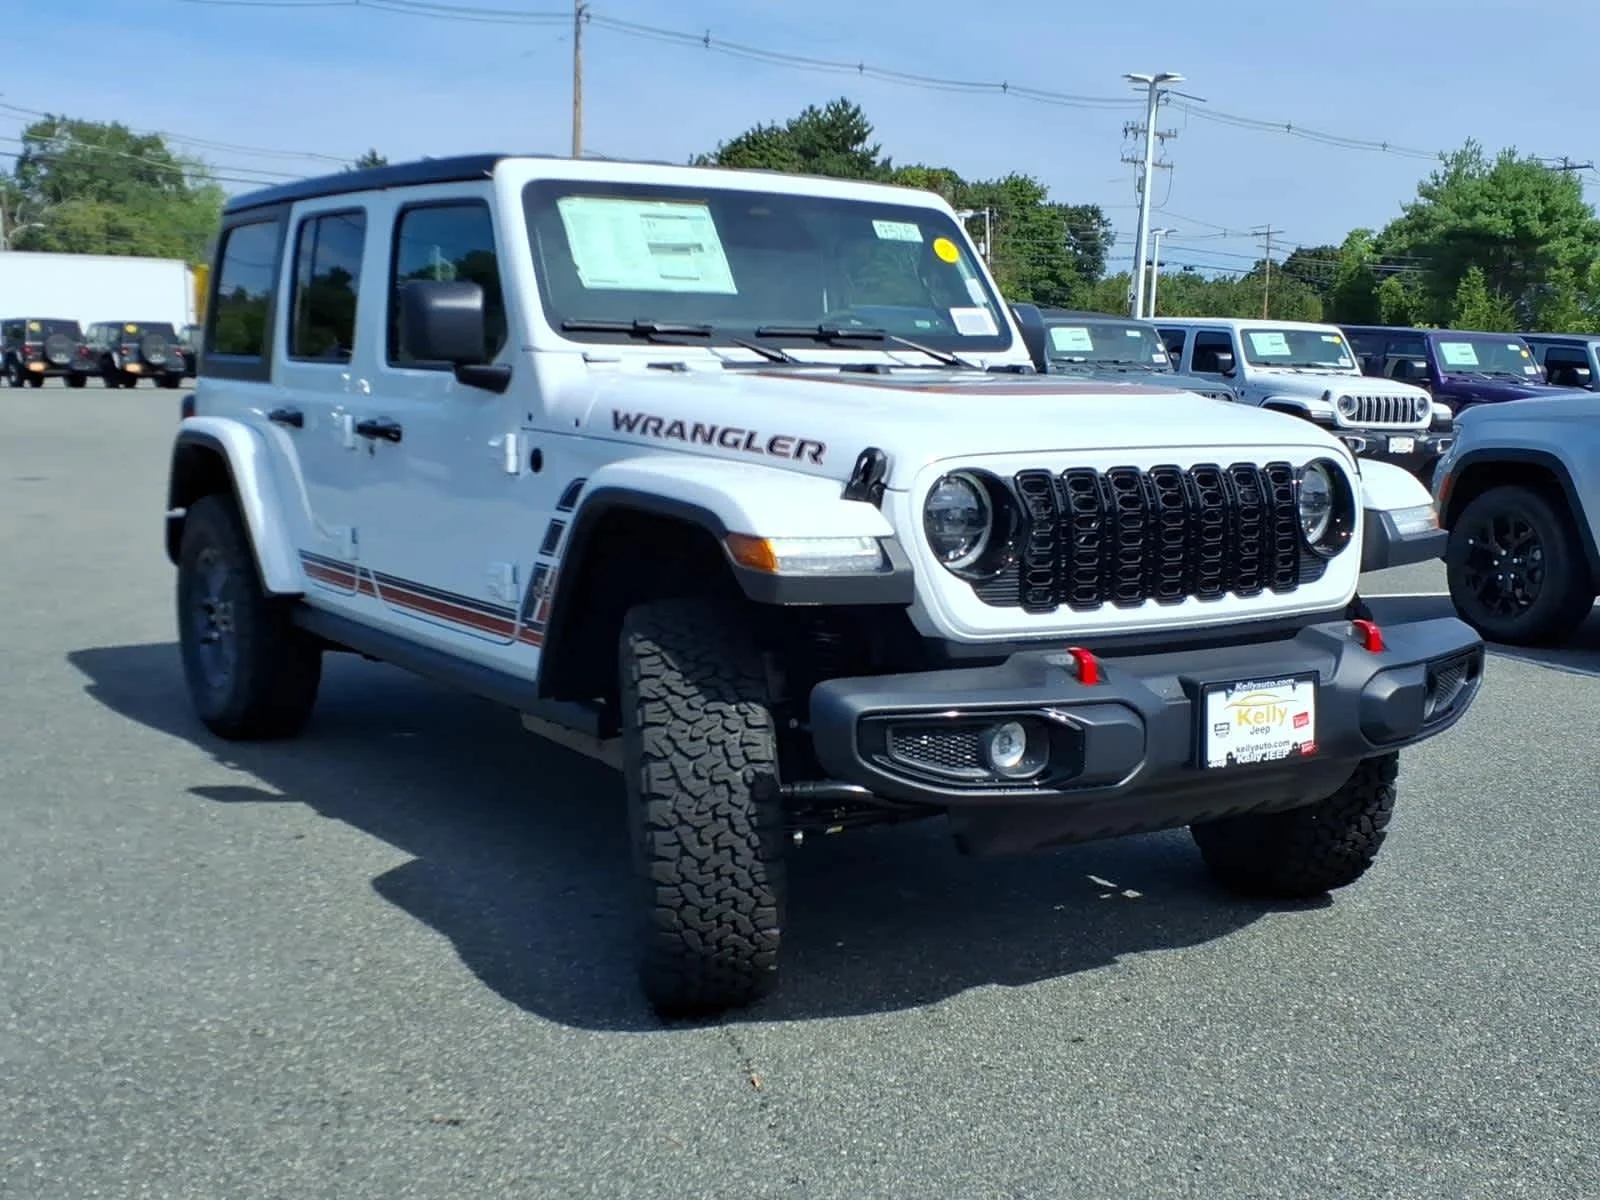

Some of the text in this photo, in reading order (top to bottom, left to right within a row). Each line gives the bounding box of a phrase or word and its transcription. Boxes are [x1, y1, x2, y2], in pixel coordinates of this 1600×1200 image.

[611, 408, 827, 466] WRANGLER
[1236, 704, 1288, 727] Kelly
[1249, 725, 1271, 735] Jeep
[1235, 740, 1290, 754] kellyauto.com
